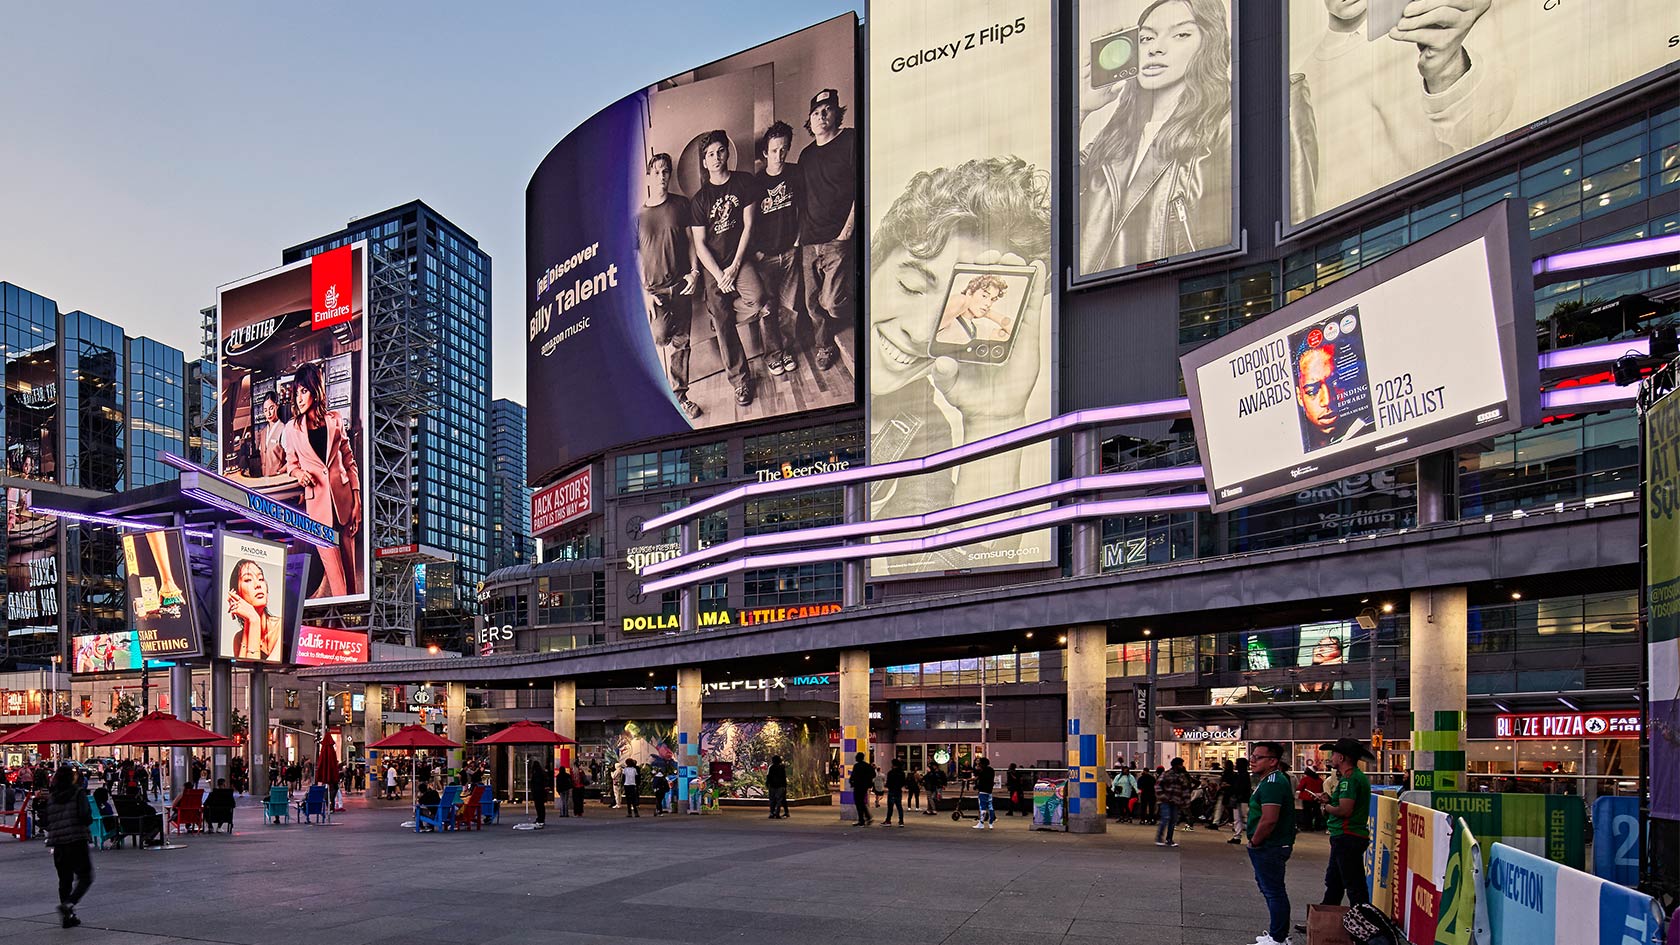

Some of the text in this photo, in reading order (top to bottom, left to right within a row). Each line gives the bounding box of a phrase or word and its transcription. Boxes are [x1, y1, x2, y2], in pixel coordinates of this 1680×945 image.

[891, 17, 1026, 73] Galaxy Z Flip5
[314, 305, 350, 323] Emirates
[530, 263, 617, 342] Billy Talent
[230, 318, 275, 346] FLY BETTER
[541, 316, 590, 355] amazon music
[1229, 338, 1285, 379] TORONTO
[1254, 358, 1289, 390] BOOK
[1238, 381, 1292, 418] AWARDS
[1336, 384, 1368, 400] FINDING
[1337, 393, 1367, 408] EDWARD
[1375, 372, 1413, 406] 2023
[1379, 385, 1446, 429] FINALIST
[756, 460, 849, 483] The Beer Store
[533, 475, 589, 518] JACK ASTOR'S
[247, 492, 335, 542] YONGE-DUNDAS SQ
[533, 500, 579, 531] PARTY IS THIS WAY
[241, 545, 267, 556] PANDORA
[968, 546, 1040, 561] samsung.com
[139, 629, 158, 641] START
[141, 637, 189, 652] SOMETHING
[325, 639, 363, 654] FITNESS
[793, 676, 830, 686] IMAX
[1138, 689, 1146, 719] DMZ
[1183, 727, 1236, 739] wine rack
[1497, 716, 1584, 737] BLAZE PIZZA
[1415, 775, 1426, 786] 20
[1436, 796, 1492, 813] CULTURE
[1551, 809, 1566, 865] GETHER
